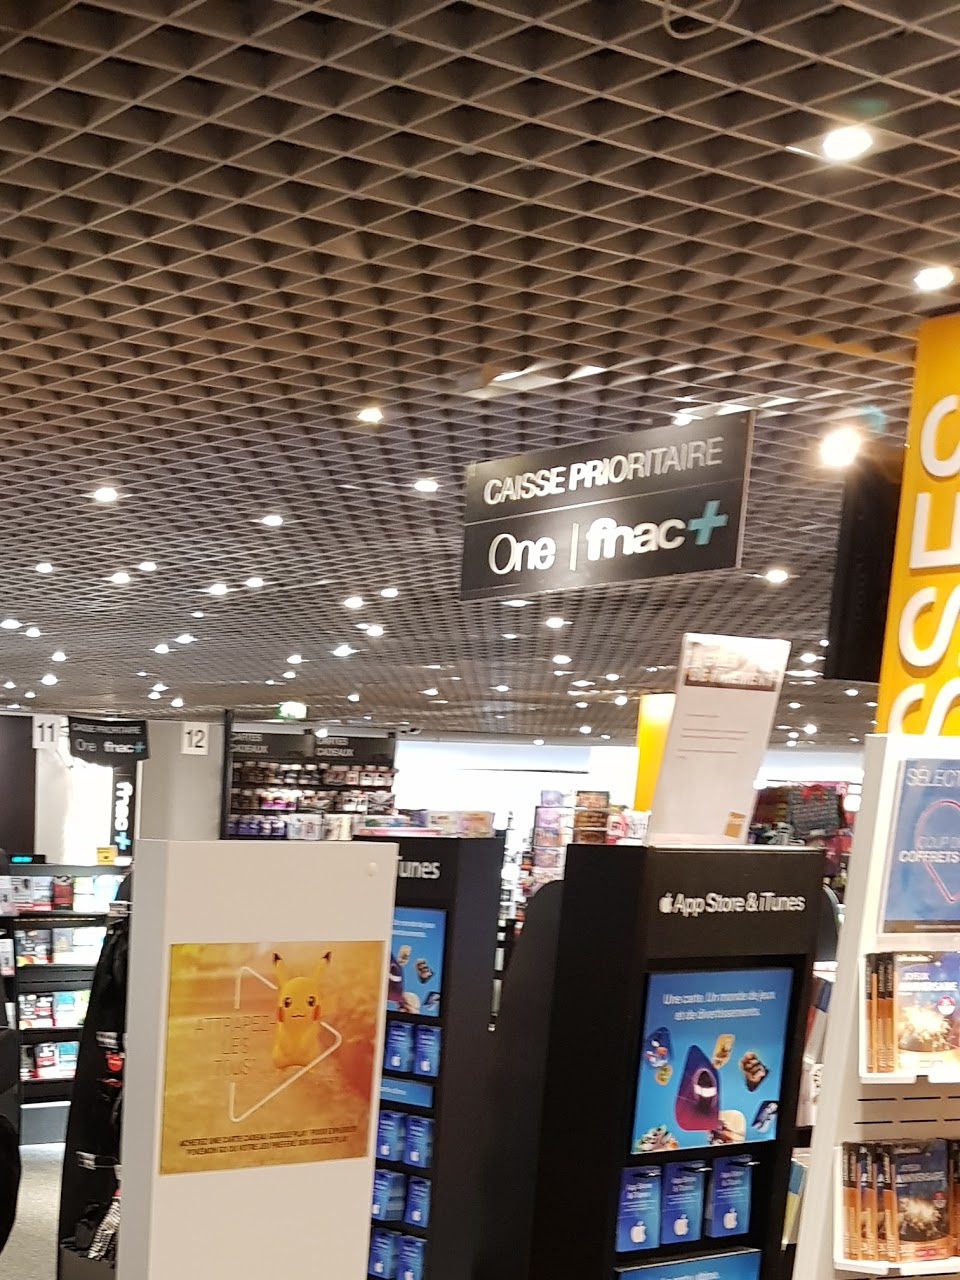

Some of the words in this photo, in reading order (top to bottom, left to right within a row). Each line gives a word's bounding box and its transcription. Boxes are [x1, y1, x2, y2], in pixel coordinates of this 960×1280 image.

[484, 466, 566, 505] CAISSE
[569, 436, 724, 490] PRIORITAIRE
[489, 533, 556, 574] One
[38, 722, 56, 742] 11
[185, 729, 206, 748] 12
[672, 893, 705, 917] App
[706, 892, 745, 912] Store
[759, 892, 806, 911] iTunes
